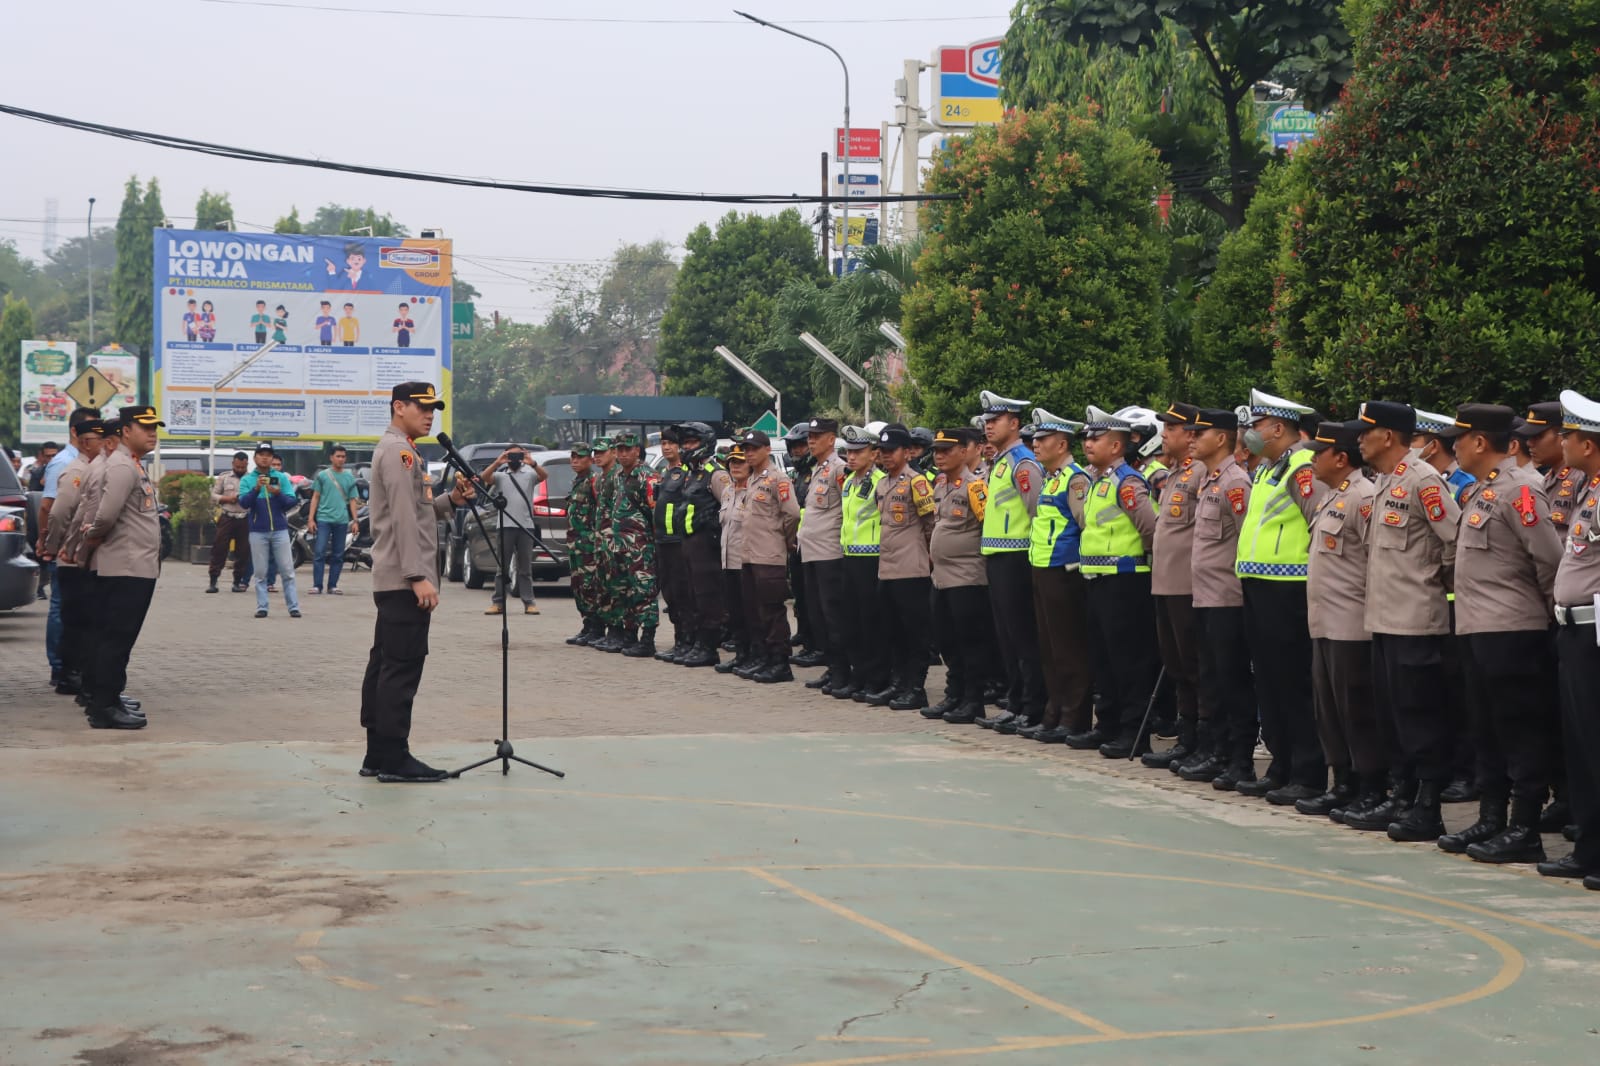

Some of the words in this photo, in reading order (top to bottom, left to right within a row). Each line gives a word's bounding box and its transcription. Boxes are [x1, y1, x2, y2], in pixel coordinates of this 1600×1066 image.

[945, 104, 961, 116] 24
[168, 239, 314, 263] LOWONGAN
[168, 258, 248, 278] KERJA
[168, 277, 183, 286] PT.
[185, 278, 249, 288] INDOMARCO
[250, 281, 314, 290] PRISMATAMA
[227, 408, 255, 417] Cabang
[257, 410, 295, 418] Tangerang
[1385, 500, 1409, 510] POLRI
[1475, 500, 1493, 513] POLRI
[1553, 500, 1571, 509] POLRI
[1327, 510, 1346, 520] POLRI
